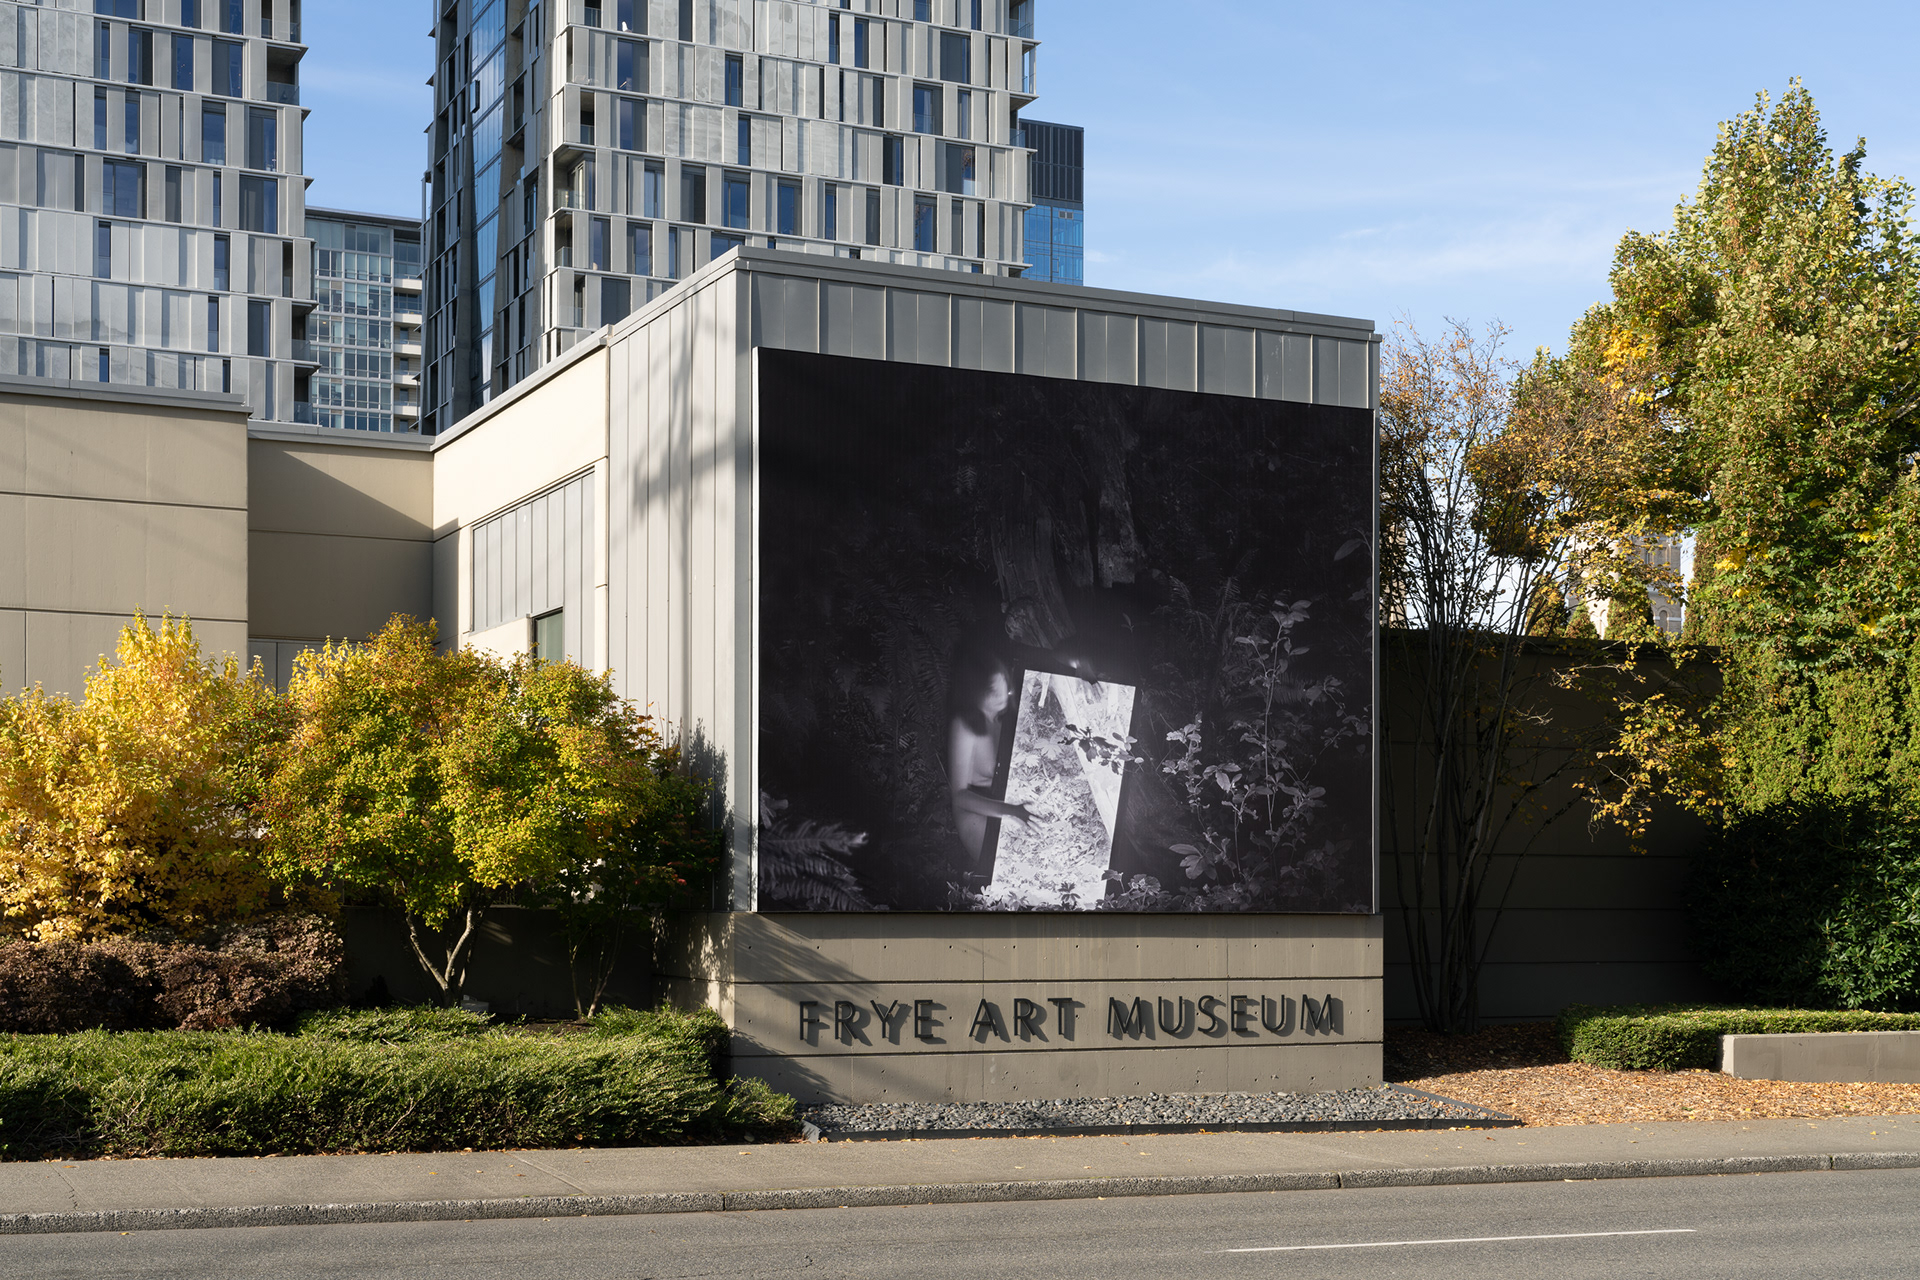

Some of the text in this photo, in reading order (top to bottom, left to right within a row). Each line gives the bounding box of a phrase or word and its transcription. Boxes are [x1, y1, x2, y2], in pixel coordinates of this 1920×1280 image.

[799, 993, 1335, 1041] FRYE ART MUSEUM
